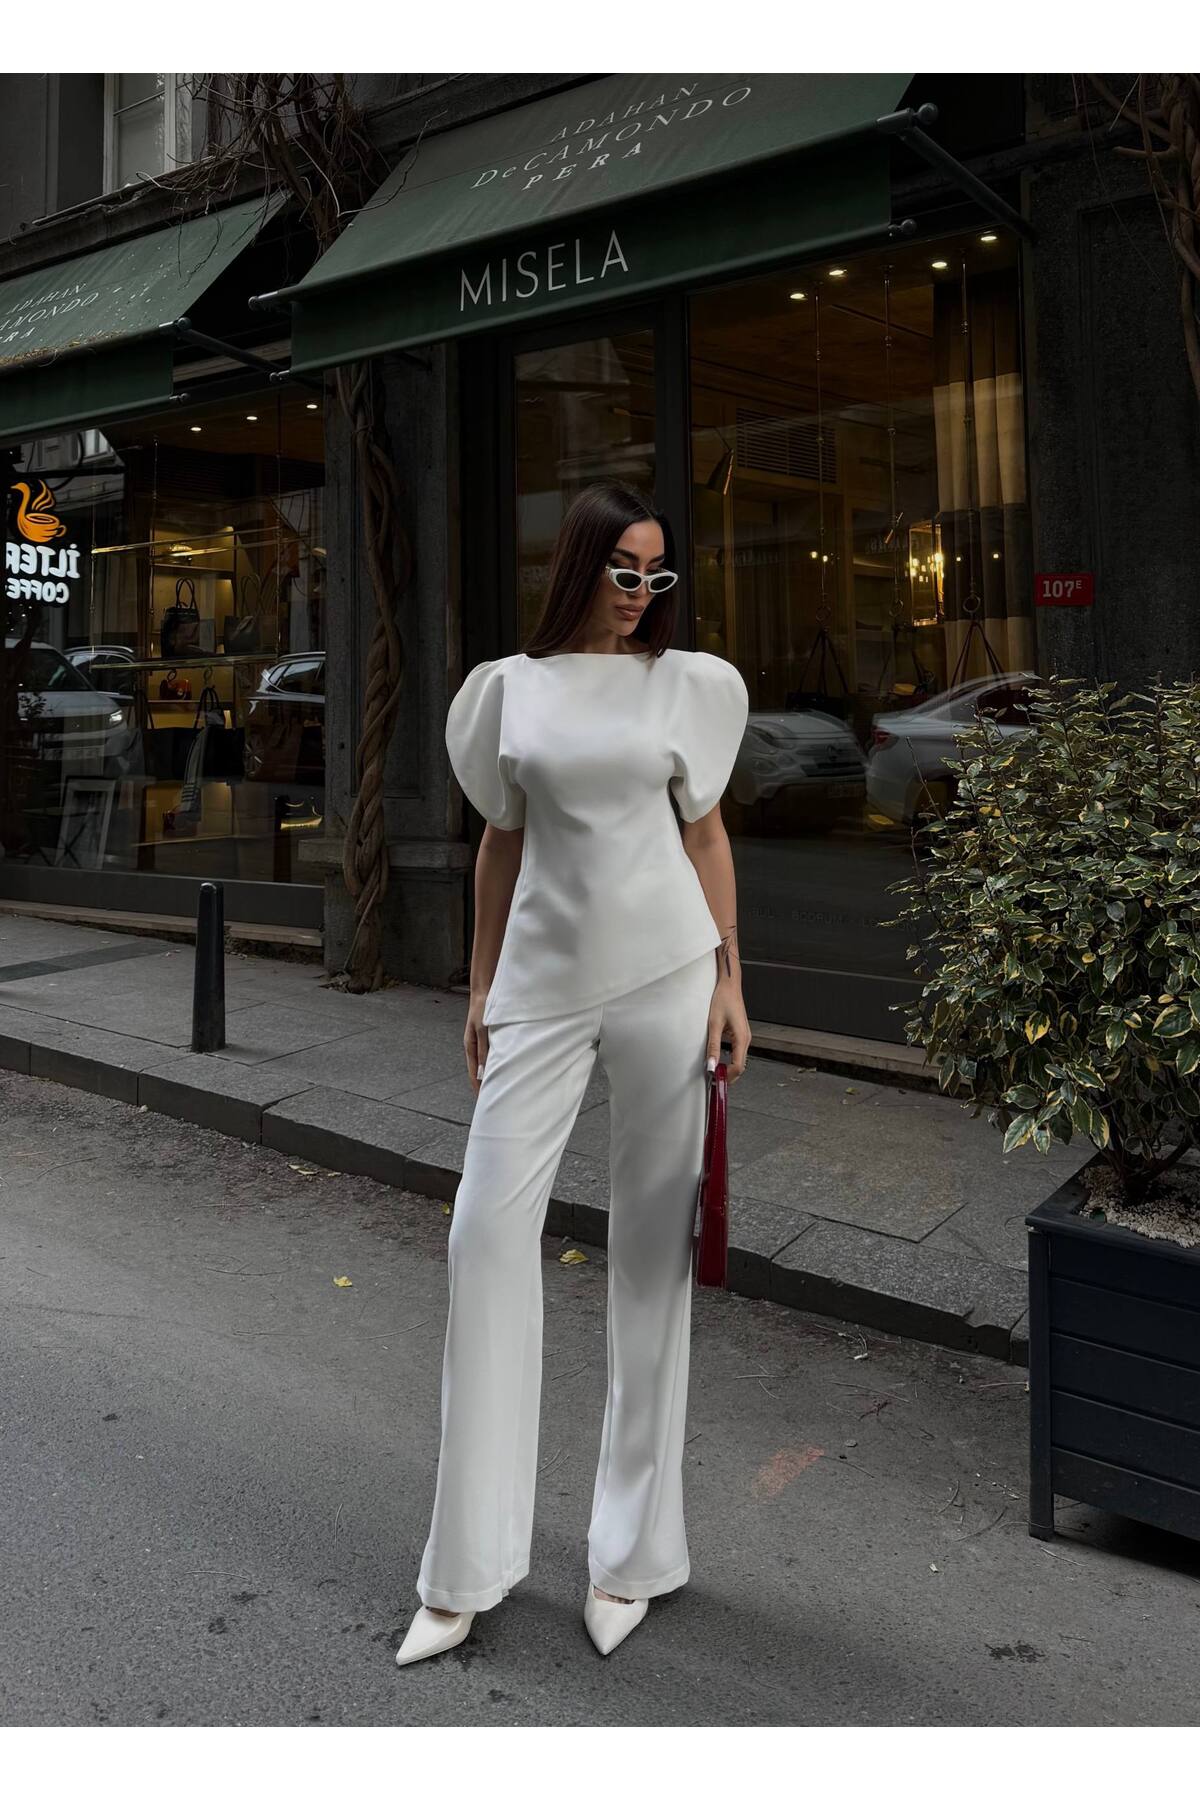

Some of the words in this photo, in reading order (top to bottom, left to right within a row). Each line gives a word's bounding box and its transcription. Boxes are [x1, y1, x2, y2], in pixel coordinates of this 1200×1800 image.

[471, 87, 751, 189] DeCAMONDO
[550, 83, 698, 142] ADAHAN
[521, 142, 642, 190] PERA
[460, 229, 629, 312] MISELA
[0, 327, 35, 343] RA
